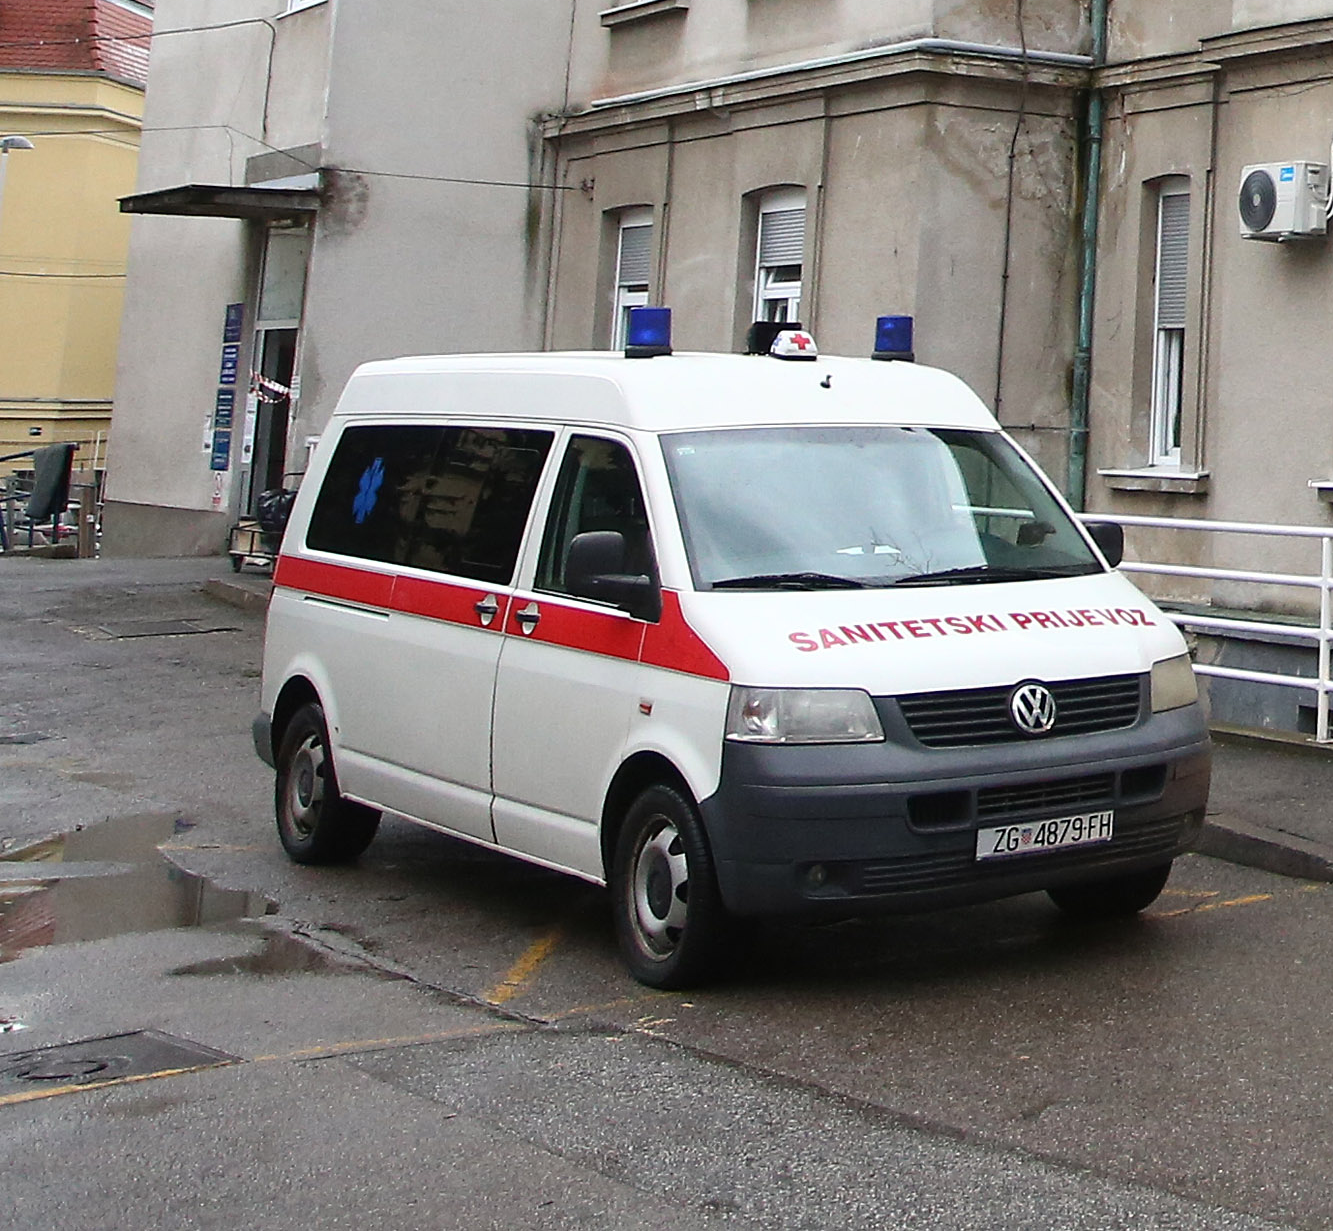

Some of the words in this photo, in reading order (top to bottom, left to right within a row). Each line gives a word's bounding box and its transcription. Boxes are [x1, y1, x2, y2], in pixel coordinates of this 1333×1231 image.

[788, 614, 1007, 652] SANITETSKI
[1008, 608, 1157, 631] PRIJEVOZ
[993, 826, 1020, 853] ZG
